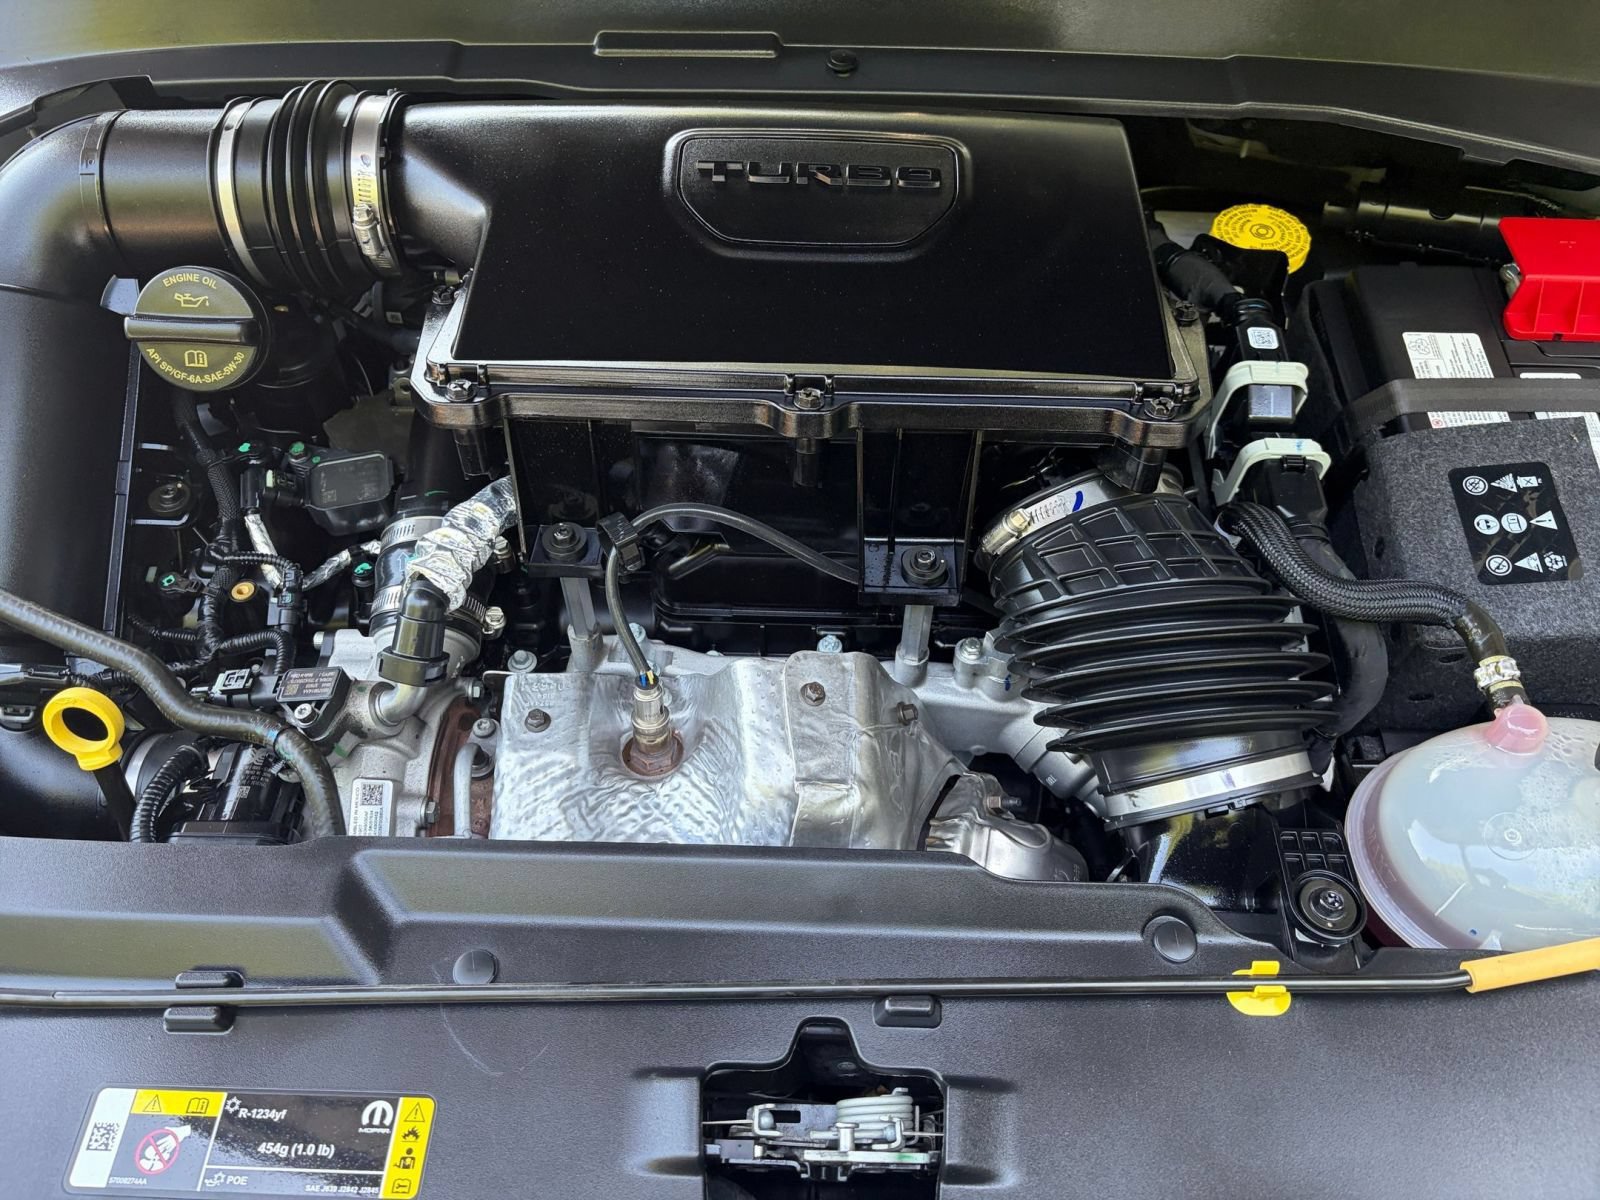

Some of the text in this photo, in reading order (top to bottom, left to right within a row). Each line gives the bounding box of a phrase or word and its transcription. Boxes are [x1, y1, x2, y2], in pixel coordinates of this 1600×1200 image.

[696, 160, 941, 188] TURBO
[162, 273, 218, 290] ENGINE OIL
[146, 348, 245, 384] API SP/GF-6A-SAE-5W-30
[238, 1108, 287, 1122] R-1234yf
[257, 1142, 336, 1159] 454g (1.0 lb)
[226, 1175, 248, 1186] POE
[305, 1184, 320, 1192] SAE
